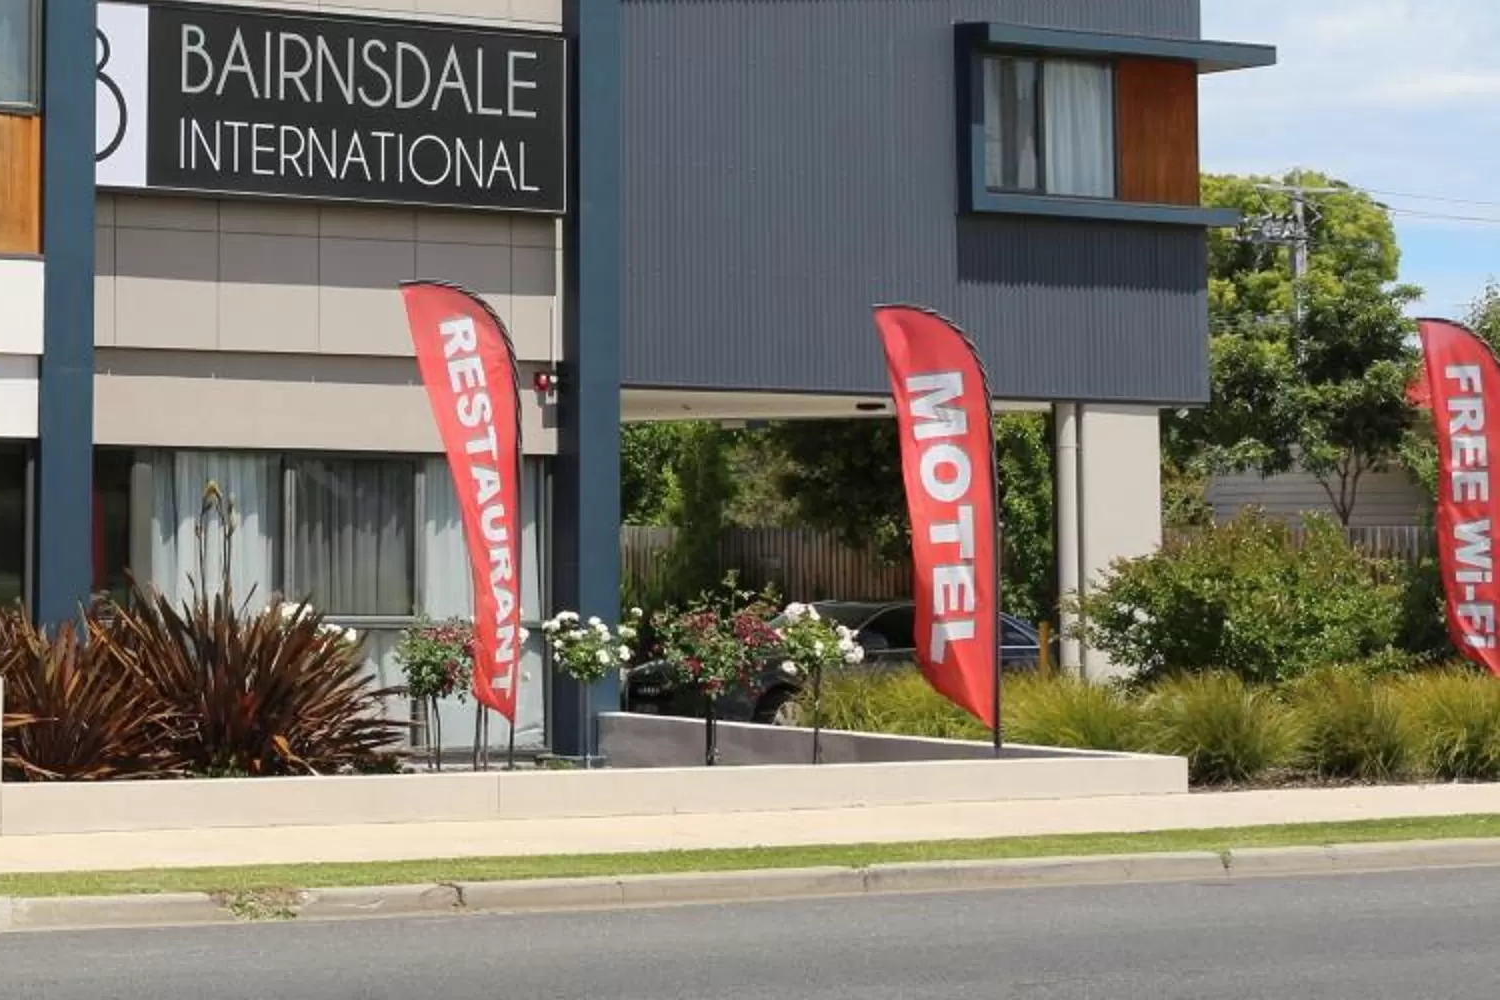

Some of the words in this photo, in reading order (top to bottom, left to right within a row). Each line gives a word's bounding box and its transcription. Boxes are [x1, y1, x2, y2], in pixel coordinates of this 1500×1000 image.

[180, 23, 538, 119] BAIRNSDALE
[179, 117, 541, 192] INTERNATIONAL
[1445, 364, 1488, 502] FREE
[439, 315, 517, 699] RESTAURANT
[905, 371, 975, 664] MOTEL
